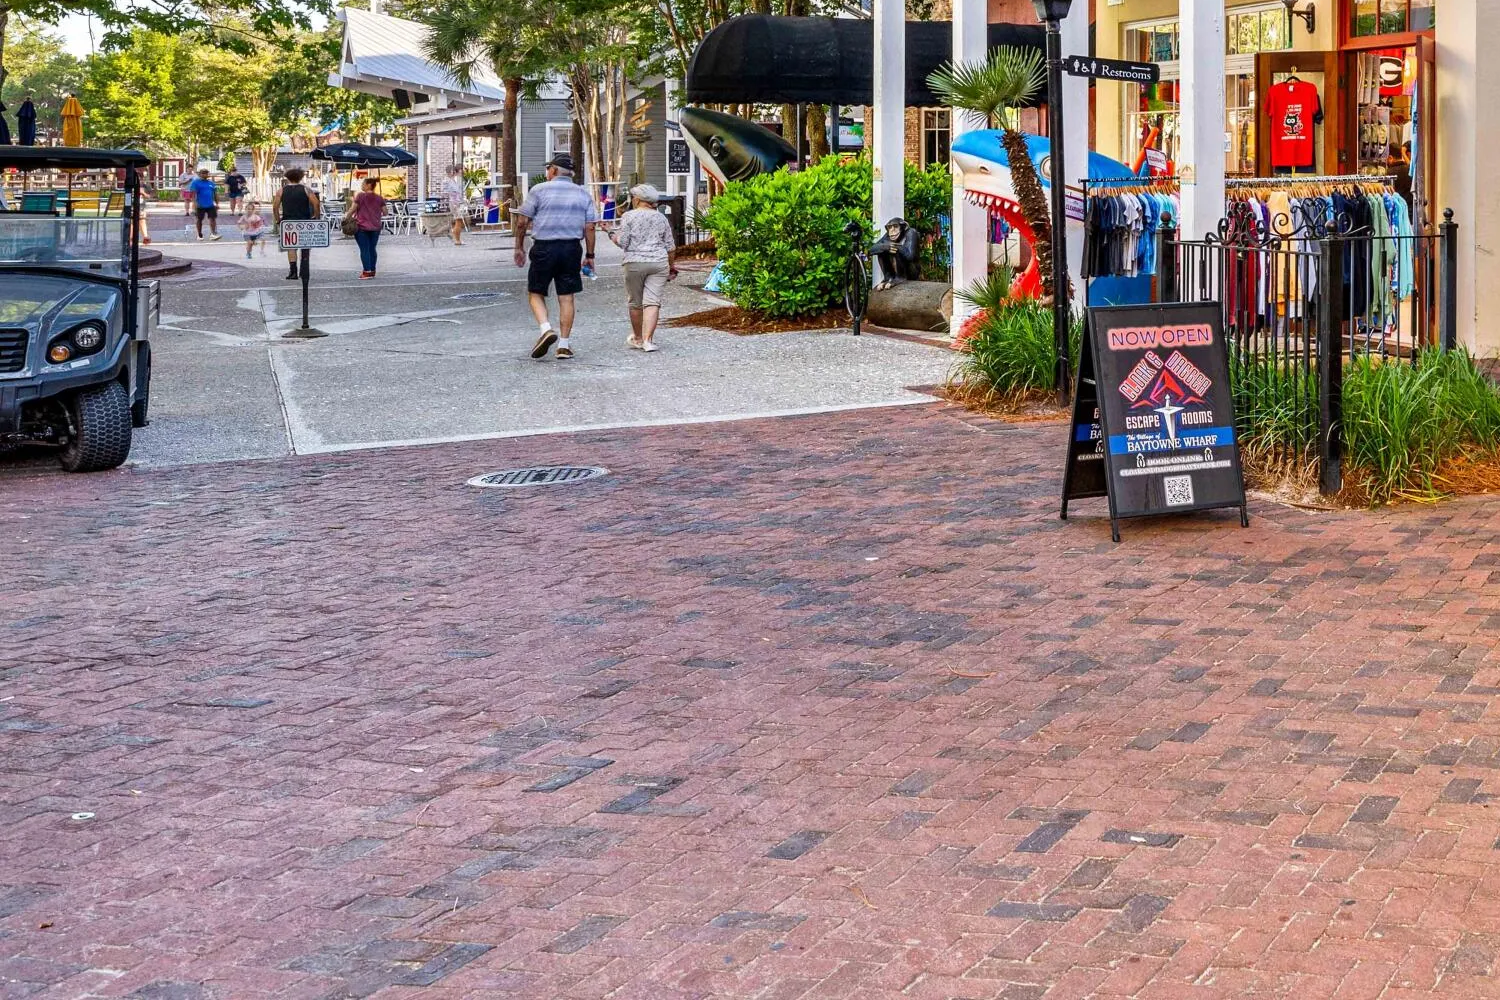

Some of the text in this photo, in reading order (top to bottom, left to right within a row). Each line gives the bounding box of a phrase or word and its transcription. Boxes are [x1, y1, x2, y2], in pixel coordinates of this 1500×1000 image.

[1101, 64, 1152, 80] Restrooms
[285, 231, 298, 245] NO
[1111, 328, 1209, 346] NOW OPEN
[1118, 360, 1157, 401] CLOAK
[1164, 350, 1212, 397] DAGGER
[1126, 410, 1213, 430] ESCAPE ROOMS
[1127, 434, 1218, 452] BAYTOWNE WHARF
[1155, 432, 1161, 440] of
